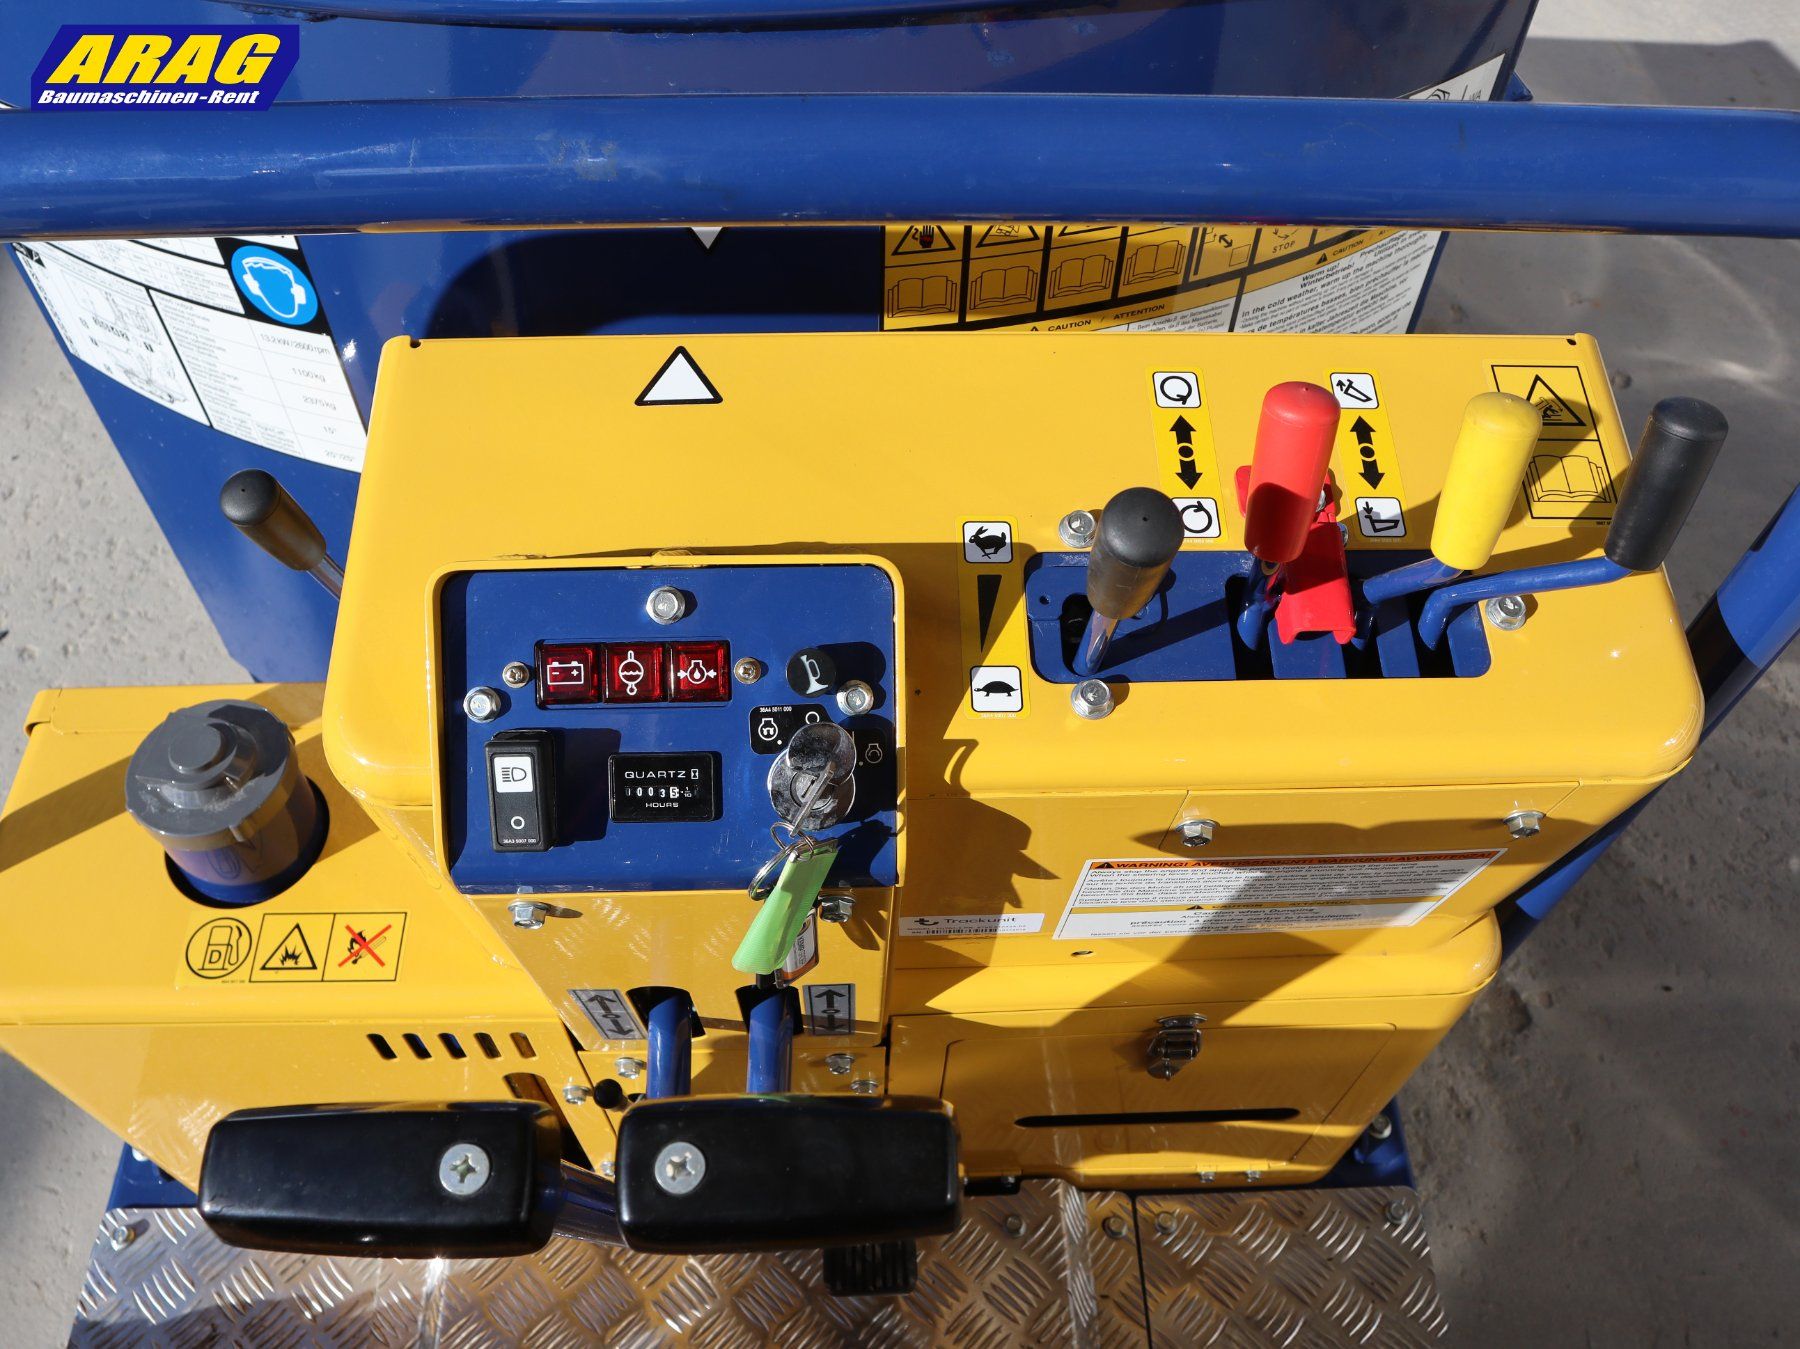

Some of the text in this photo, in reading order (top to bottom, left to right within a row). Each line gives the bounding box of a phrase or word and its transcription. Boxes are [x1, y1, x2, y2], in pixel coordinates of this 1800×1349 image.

[1272, 241, 1295, 254] STOP
[1332, 239, 1364, 256] CAUTION
[1302, 269, 1325, 281] Warm
[1252, 305, 1266, 315] the
[1267, 297, 1286, 309] cold
[1048, 303, 1166, 332] CAUTION ATTENTION
[624, 770, 686, 779] QUARTZ
[944, 916, 1017, 925] Trackunit
